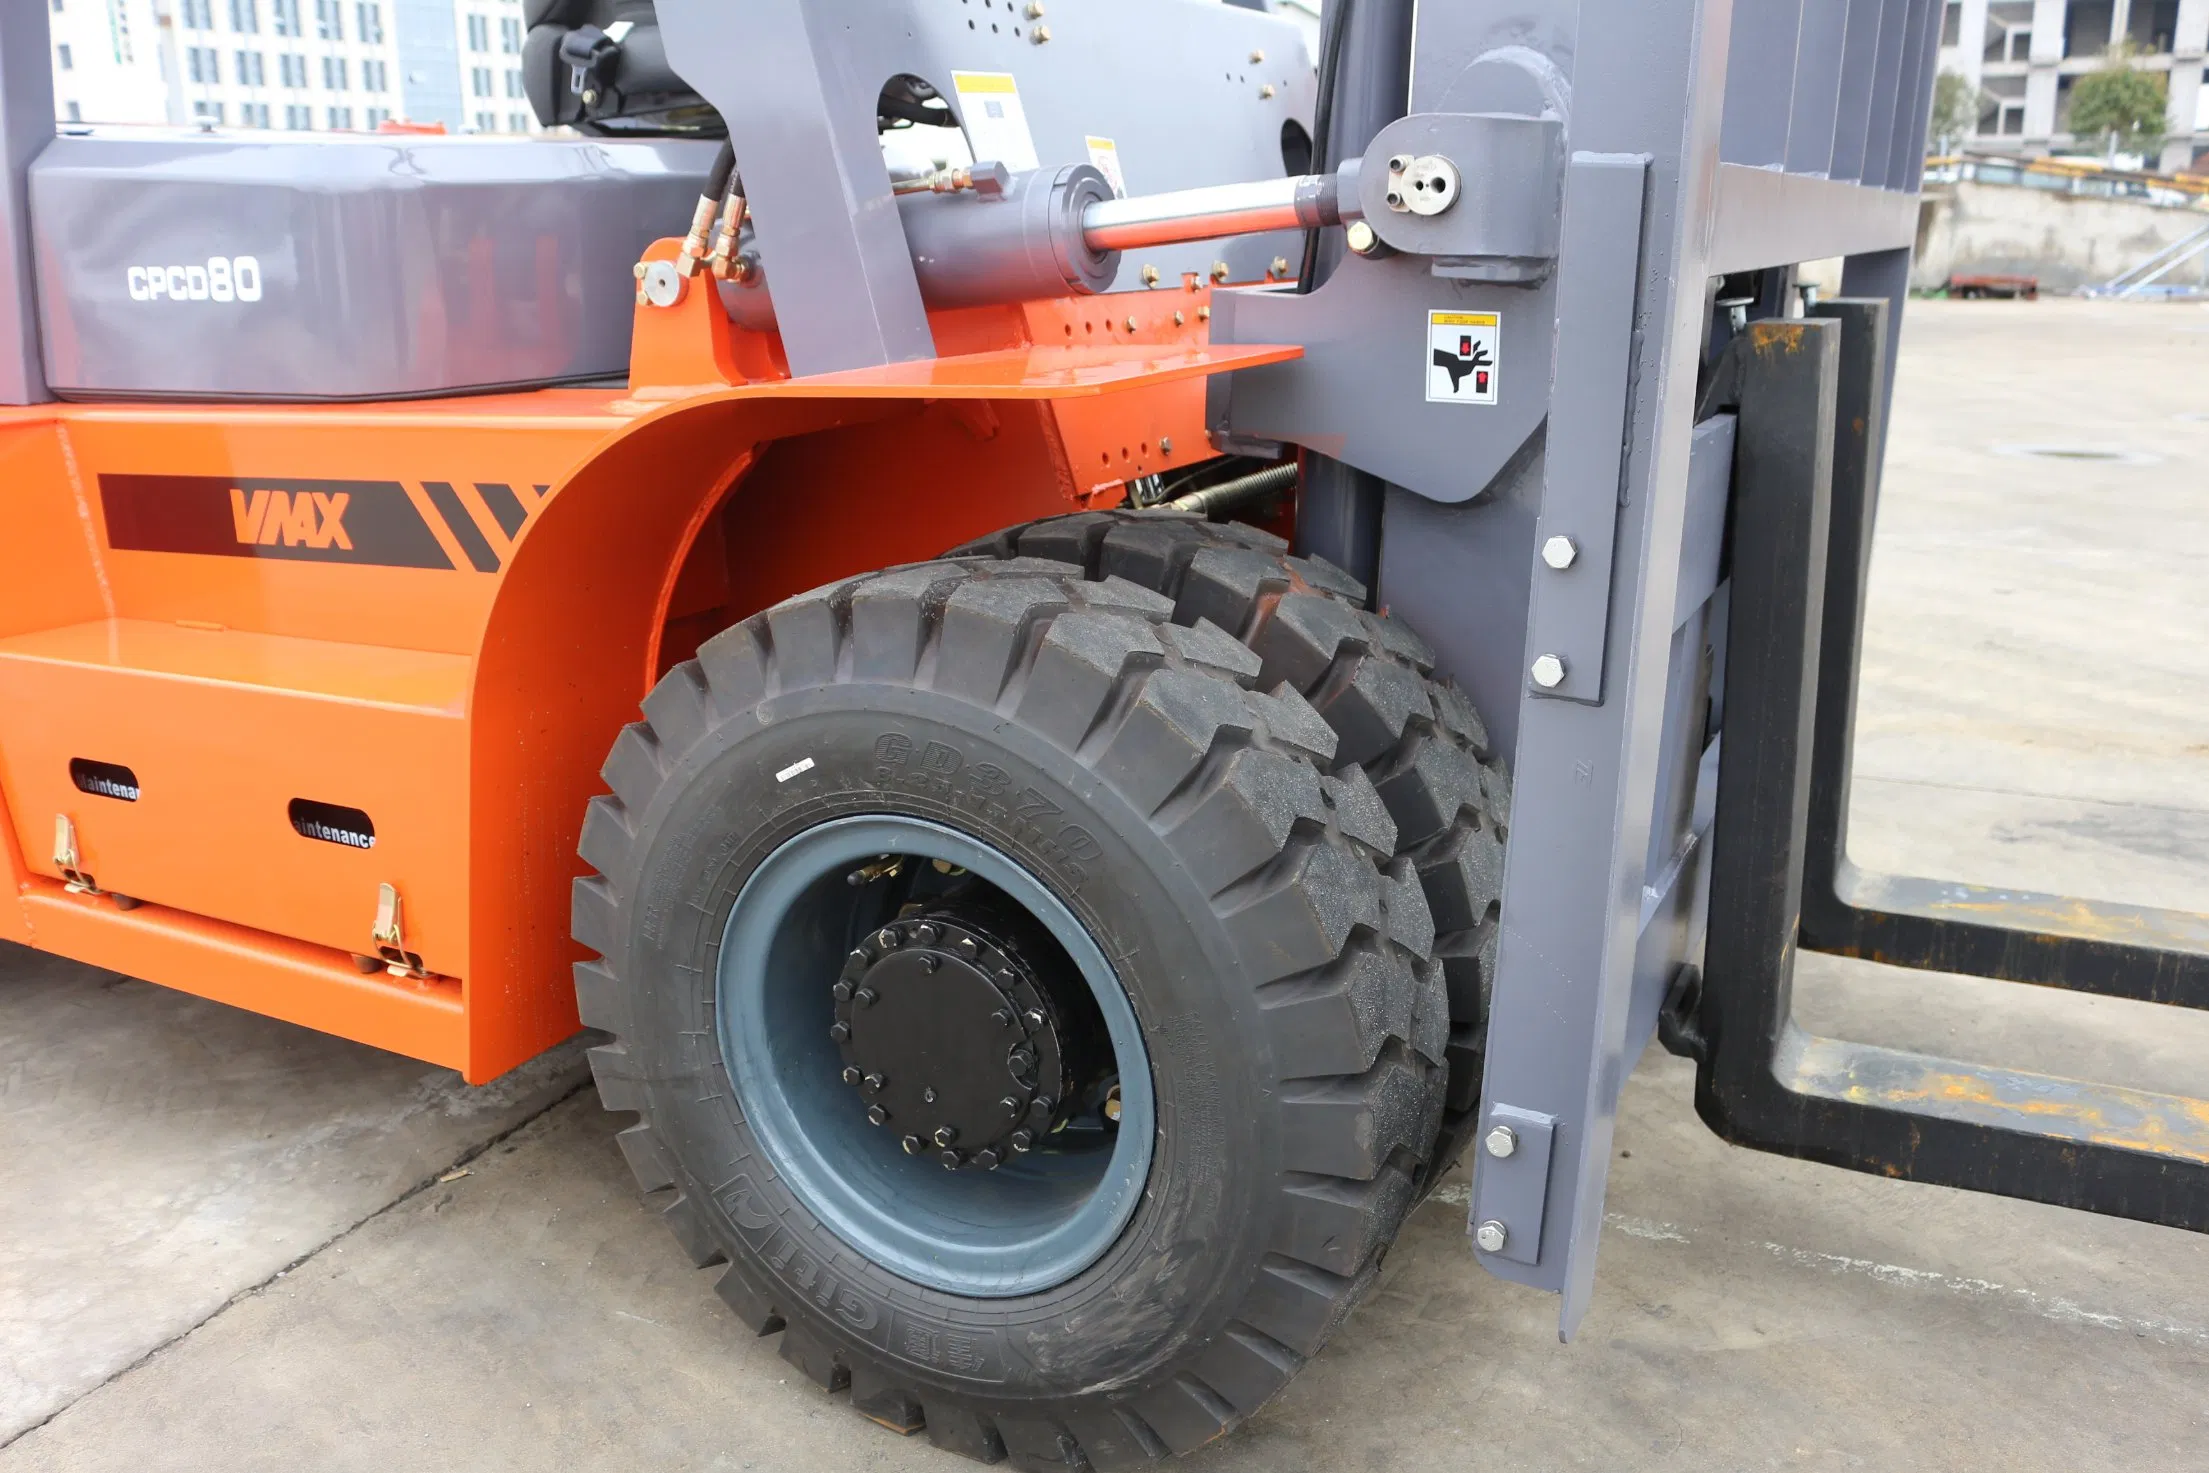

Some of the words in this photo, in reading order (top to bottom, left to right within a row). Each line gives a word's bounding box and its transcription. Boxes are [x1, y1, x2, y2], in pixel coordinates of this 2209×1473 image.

[127, 256, 262, 302] CPCD80
[229, 489, 353, 550] VMAX
[875, 732, 1103, 861] GD370
[771, 1239, 878, 1330] Giti
